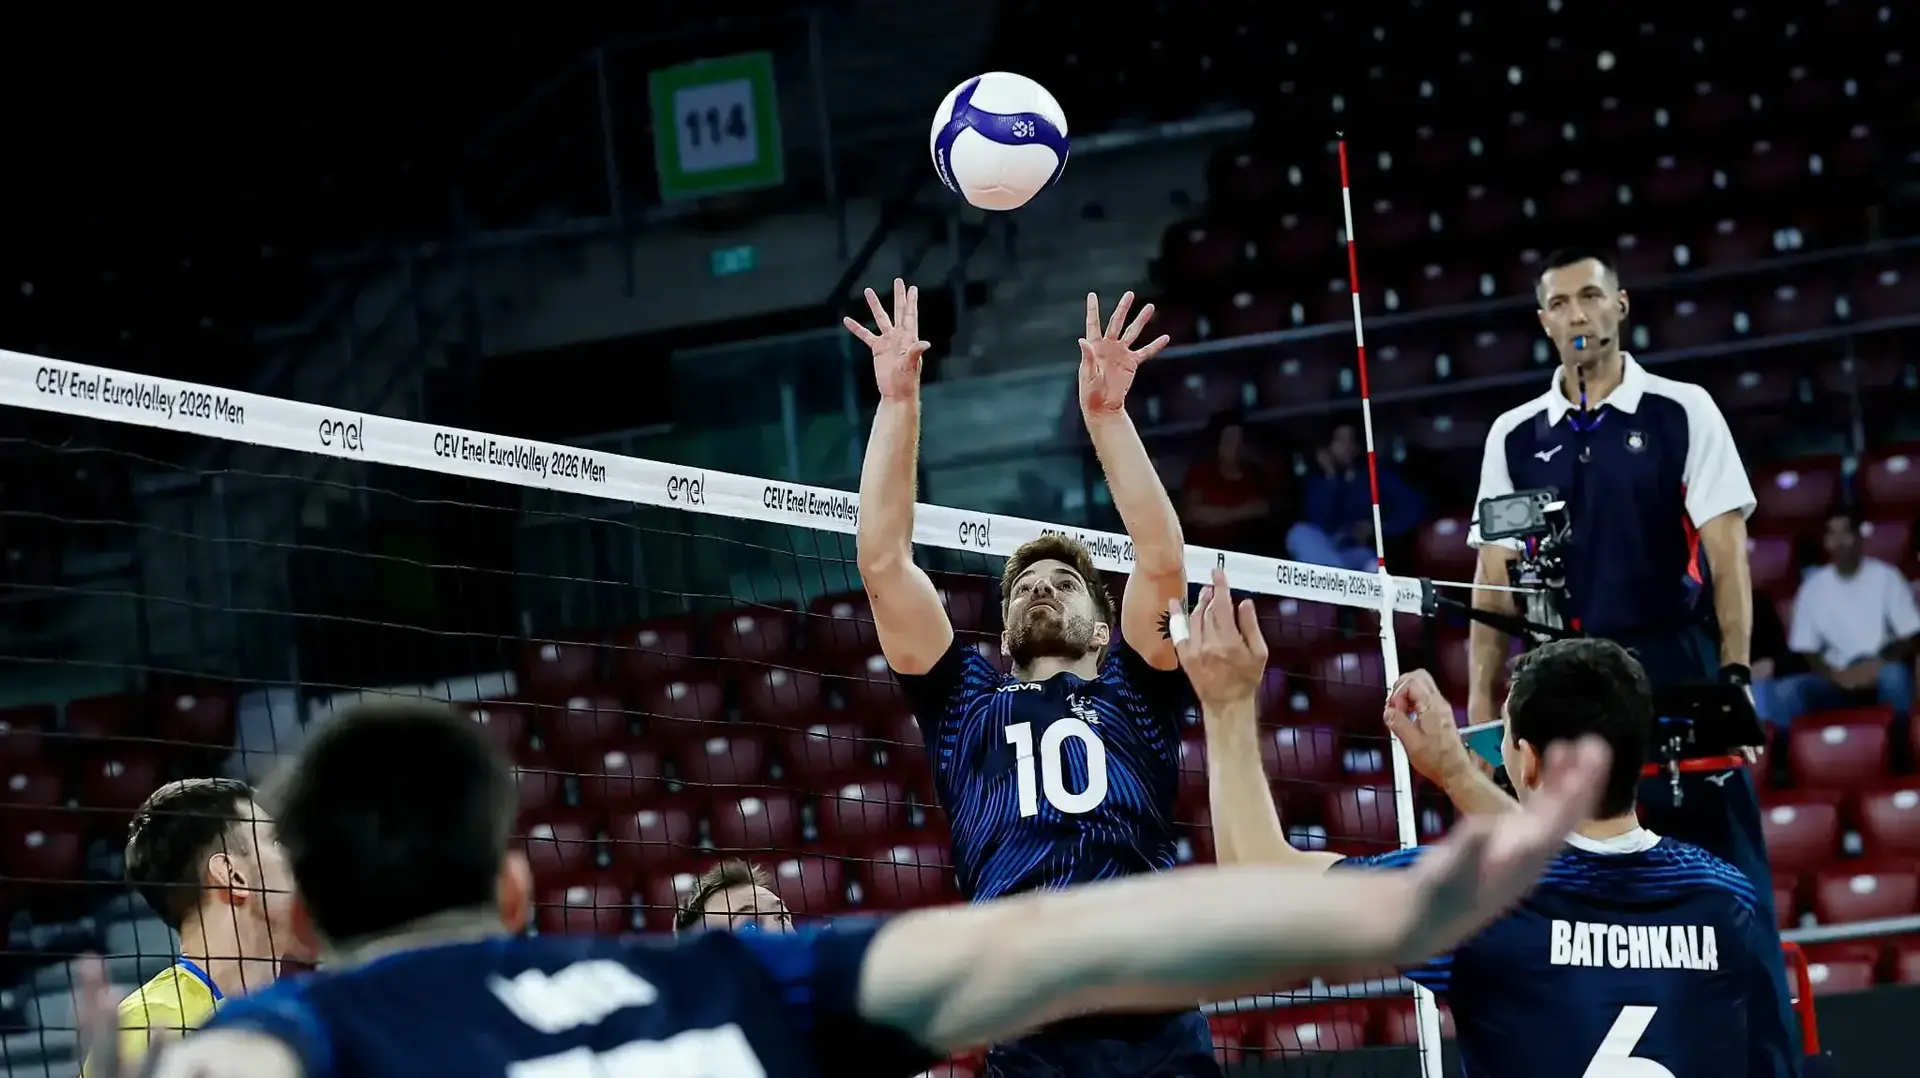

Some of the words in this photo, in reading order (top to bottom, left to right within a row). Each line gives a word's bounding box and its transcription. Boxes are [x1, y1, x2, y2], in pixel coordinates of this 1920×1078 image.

[685, 103, 748, 147] 114
[36, 366, 68, 395] CEV
[69, 372, 100, 402] Enel
[102, 377, 175, 419] EuroVolley
[179, 390, 211, 419] 2026
[214, 398, 245, 425] Men
[318, 417, 364, 452] enel
[434, 432, 459, 459] CEV
[461, 437, 487, 463] Enel
[488, 442, 549, 479] EuroVolley
[551, 452, 579, 479] 2026
[581, 457, 607, 484] Men
[666, 473, 705, 506] enel
[763, 486, 786, 510] CEV
[787, 489, 807, 513] Enel
[808, 492, 860, 527] EuroVolley
[958, 518, 991, 548] enel
[1276, 565, 1293, 585] CEV
[1293, 567, 1310, 587] Enel
[1310, 570, 1348, 597] EuroVolley
[1348, 575, 1367, 596] 2026
[1004, 717, 1108, 818] 10
[1550, 919, 1719, 971] BATCHKALA
